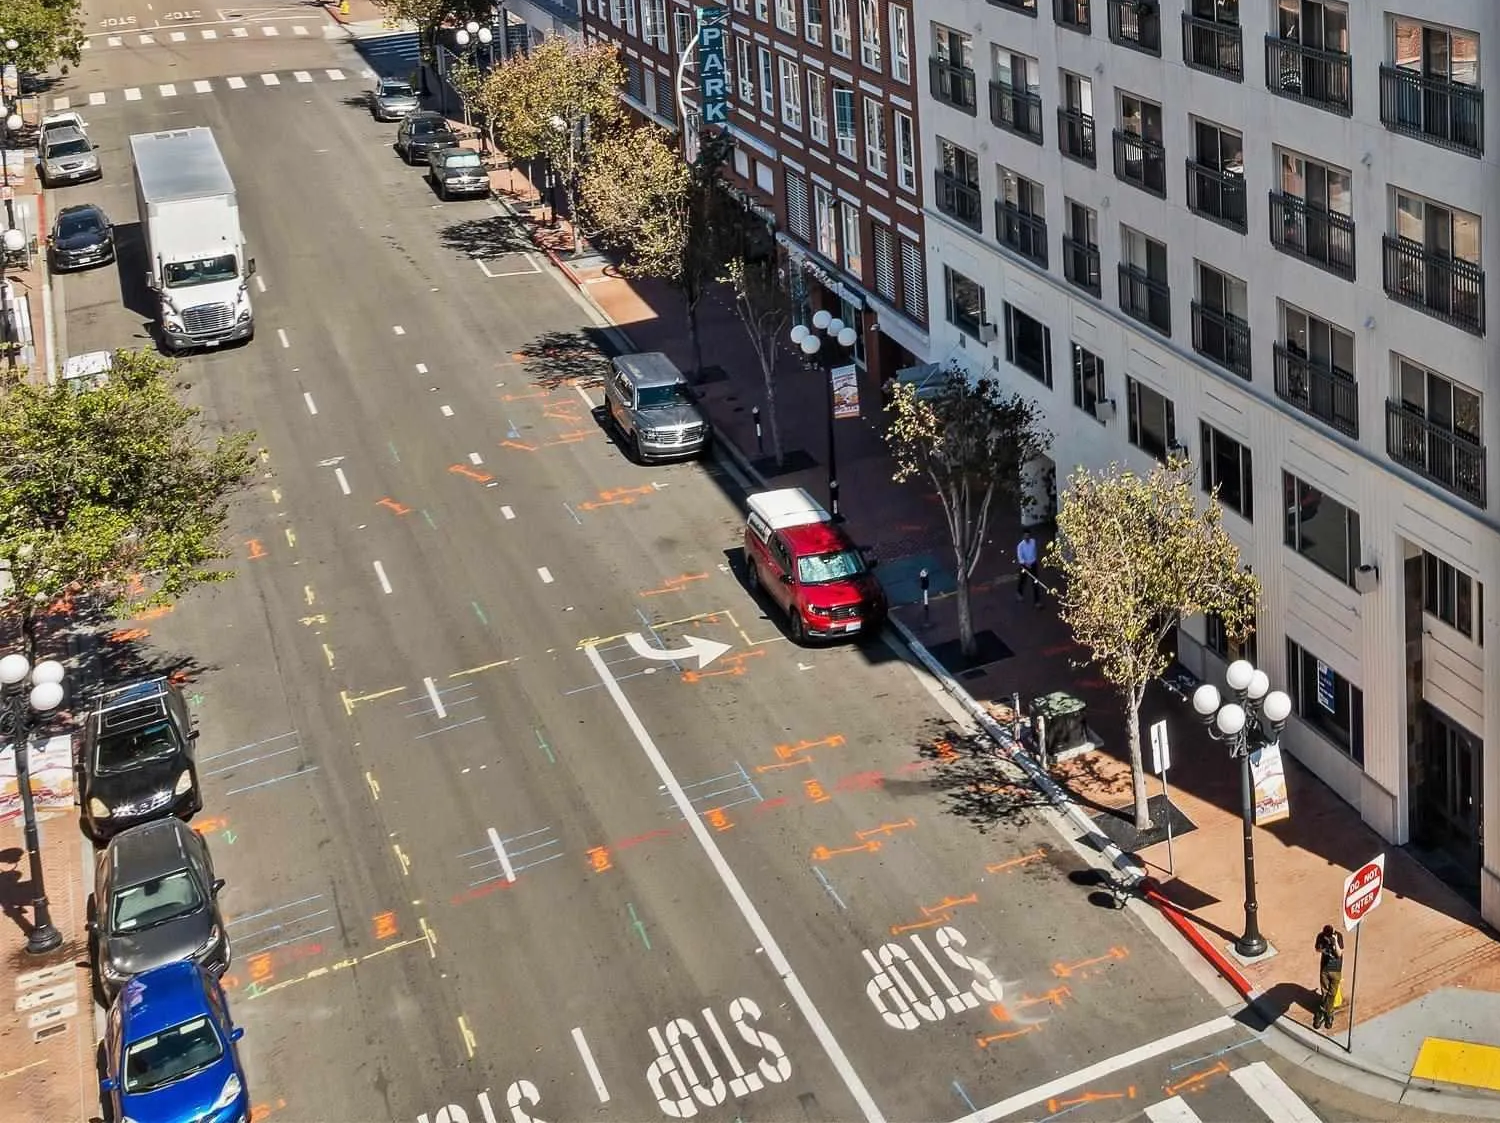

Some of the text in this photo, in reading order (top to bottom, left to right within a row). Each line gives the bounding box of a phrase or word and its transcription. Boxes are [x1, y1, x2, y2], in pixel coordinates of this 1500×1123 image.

[702, 27, 727, 122] PARK
[1349, 867, 1379, 894] DO NOT
[1350, 892, 1374, 915] ENTER
[861, 926, 1003, 1030] STOP
[646, 996, 792, 1119] STOP
